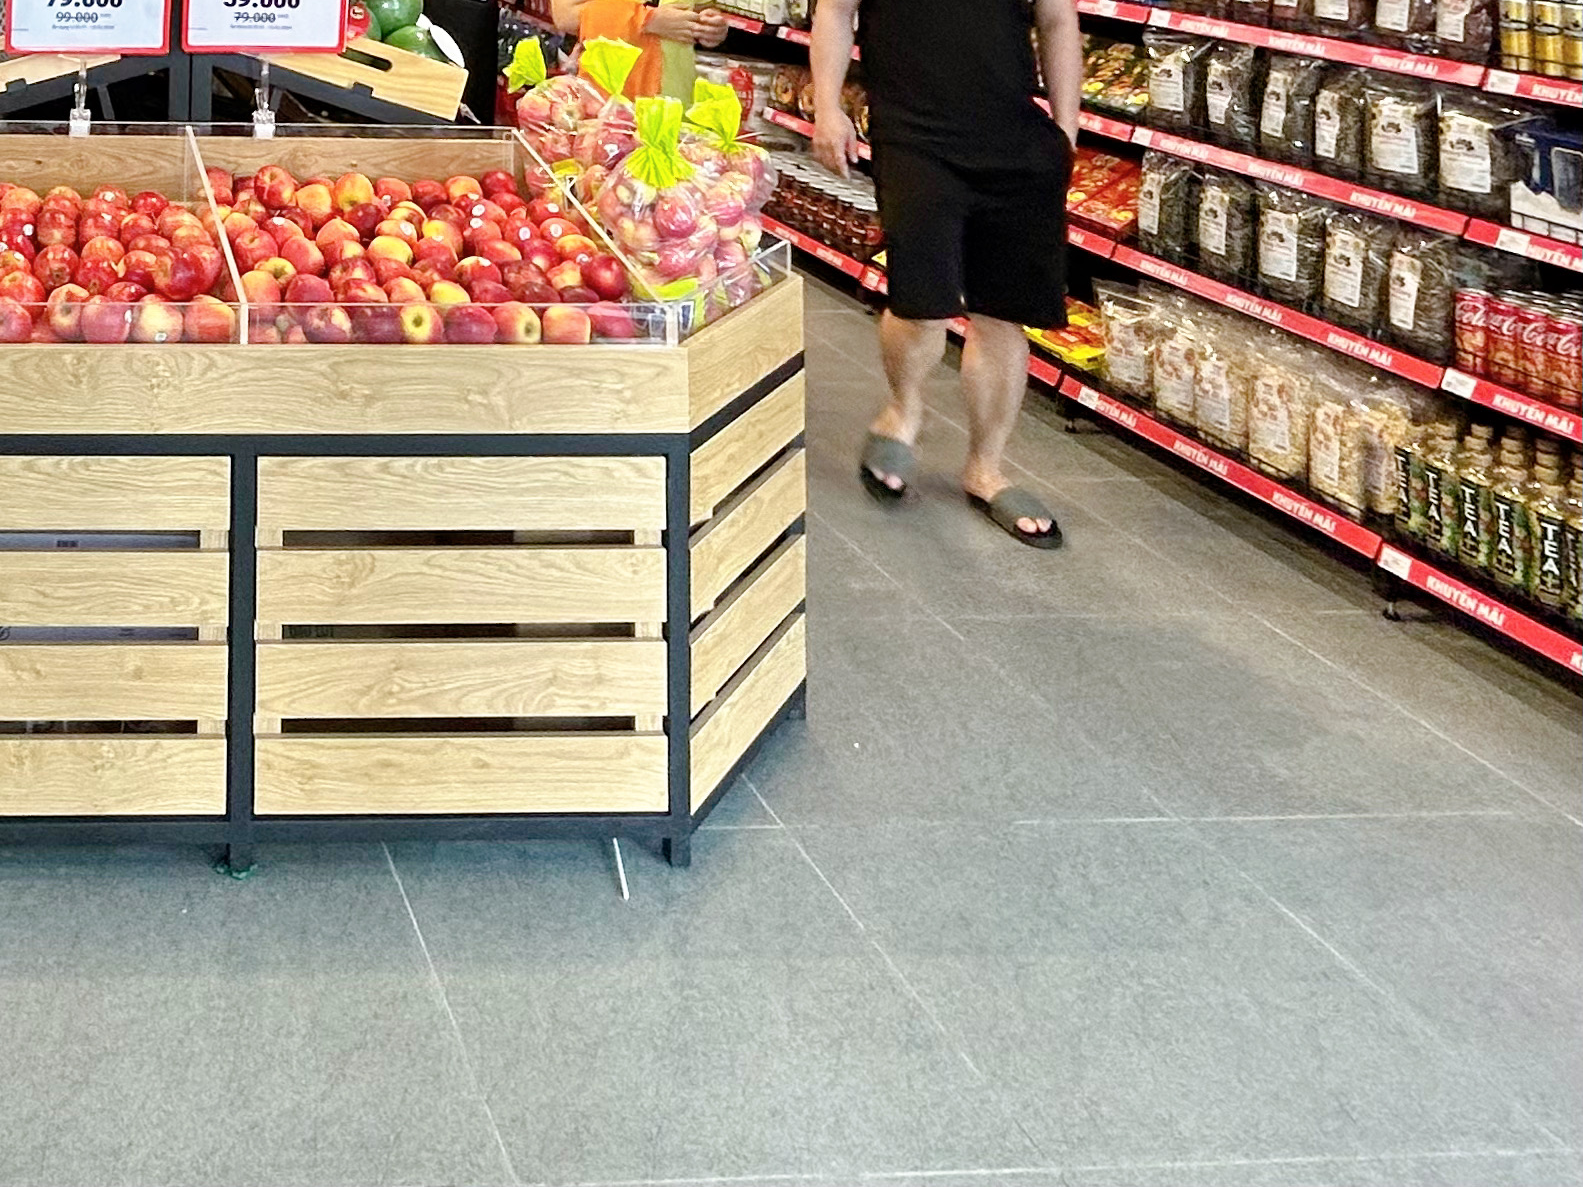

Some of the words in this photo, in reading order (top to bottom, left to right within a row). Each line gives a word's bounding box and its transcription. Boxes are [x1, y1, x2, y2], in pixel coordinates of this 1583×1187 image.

[55, 12, 99, 23] 99.000
[234, 12, 276, 23] 79.000
[1426, 575, 1478, 611] KHUYẾN
[1476, 605, 1506, 626] MÃI
